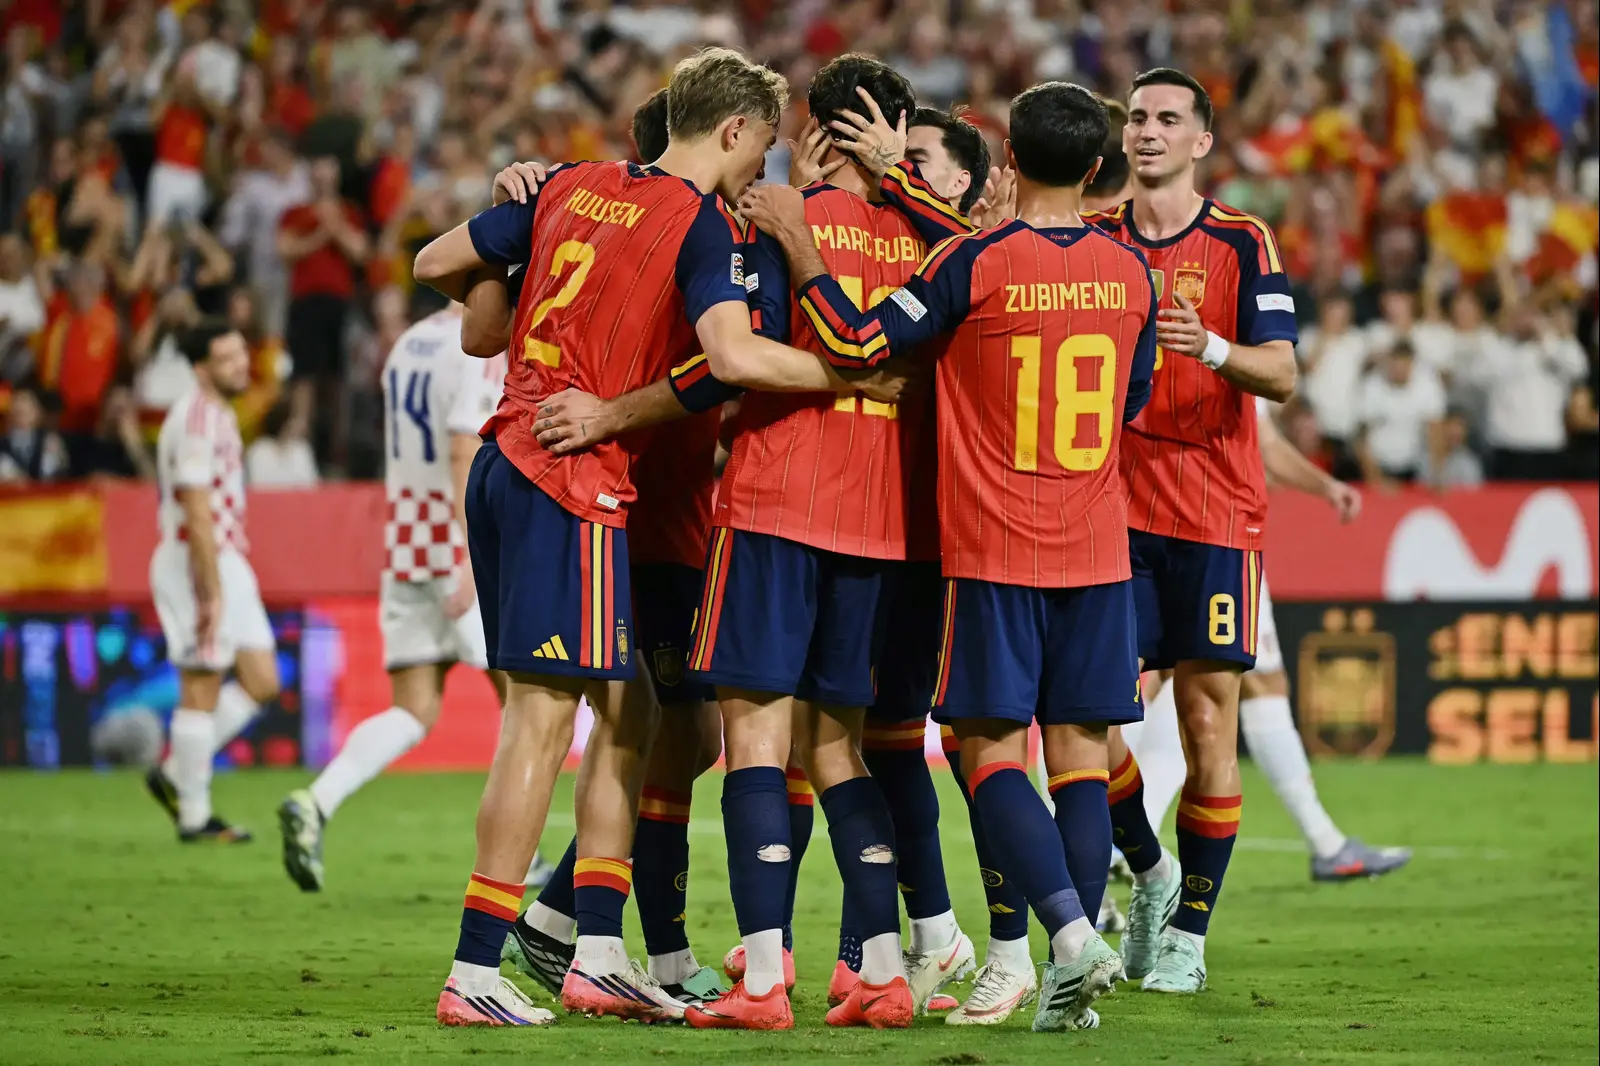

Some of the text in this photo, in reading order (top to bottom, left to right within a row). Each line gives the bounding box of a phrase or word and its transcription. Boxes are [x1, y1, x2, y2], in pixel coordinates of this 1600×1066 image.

[564, 187, 647, 230] HUIJSEN
[811, 224, 873, 258] MARC
[522, 239, 597, 368] 2
[1005, 281, 1127, 313] ZUBIMENDI
[388, 368, 436, 463] 14
[1010, 333, 1117, 472] 18
[1208, 593, 1235, 645] 8
[1427, 688, 1598, 765] SEL
